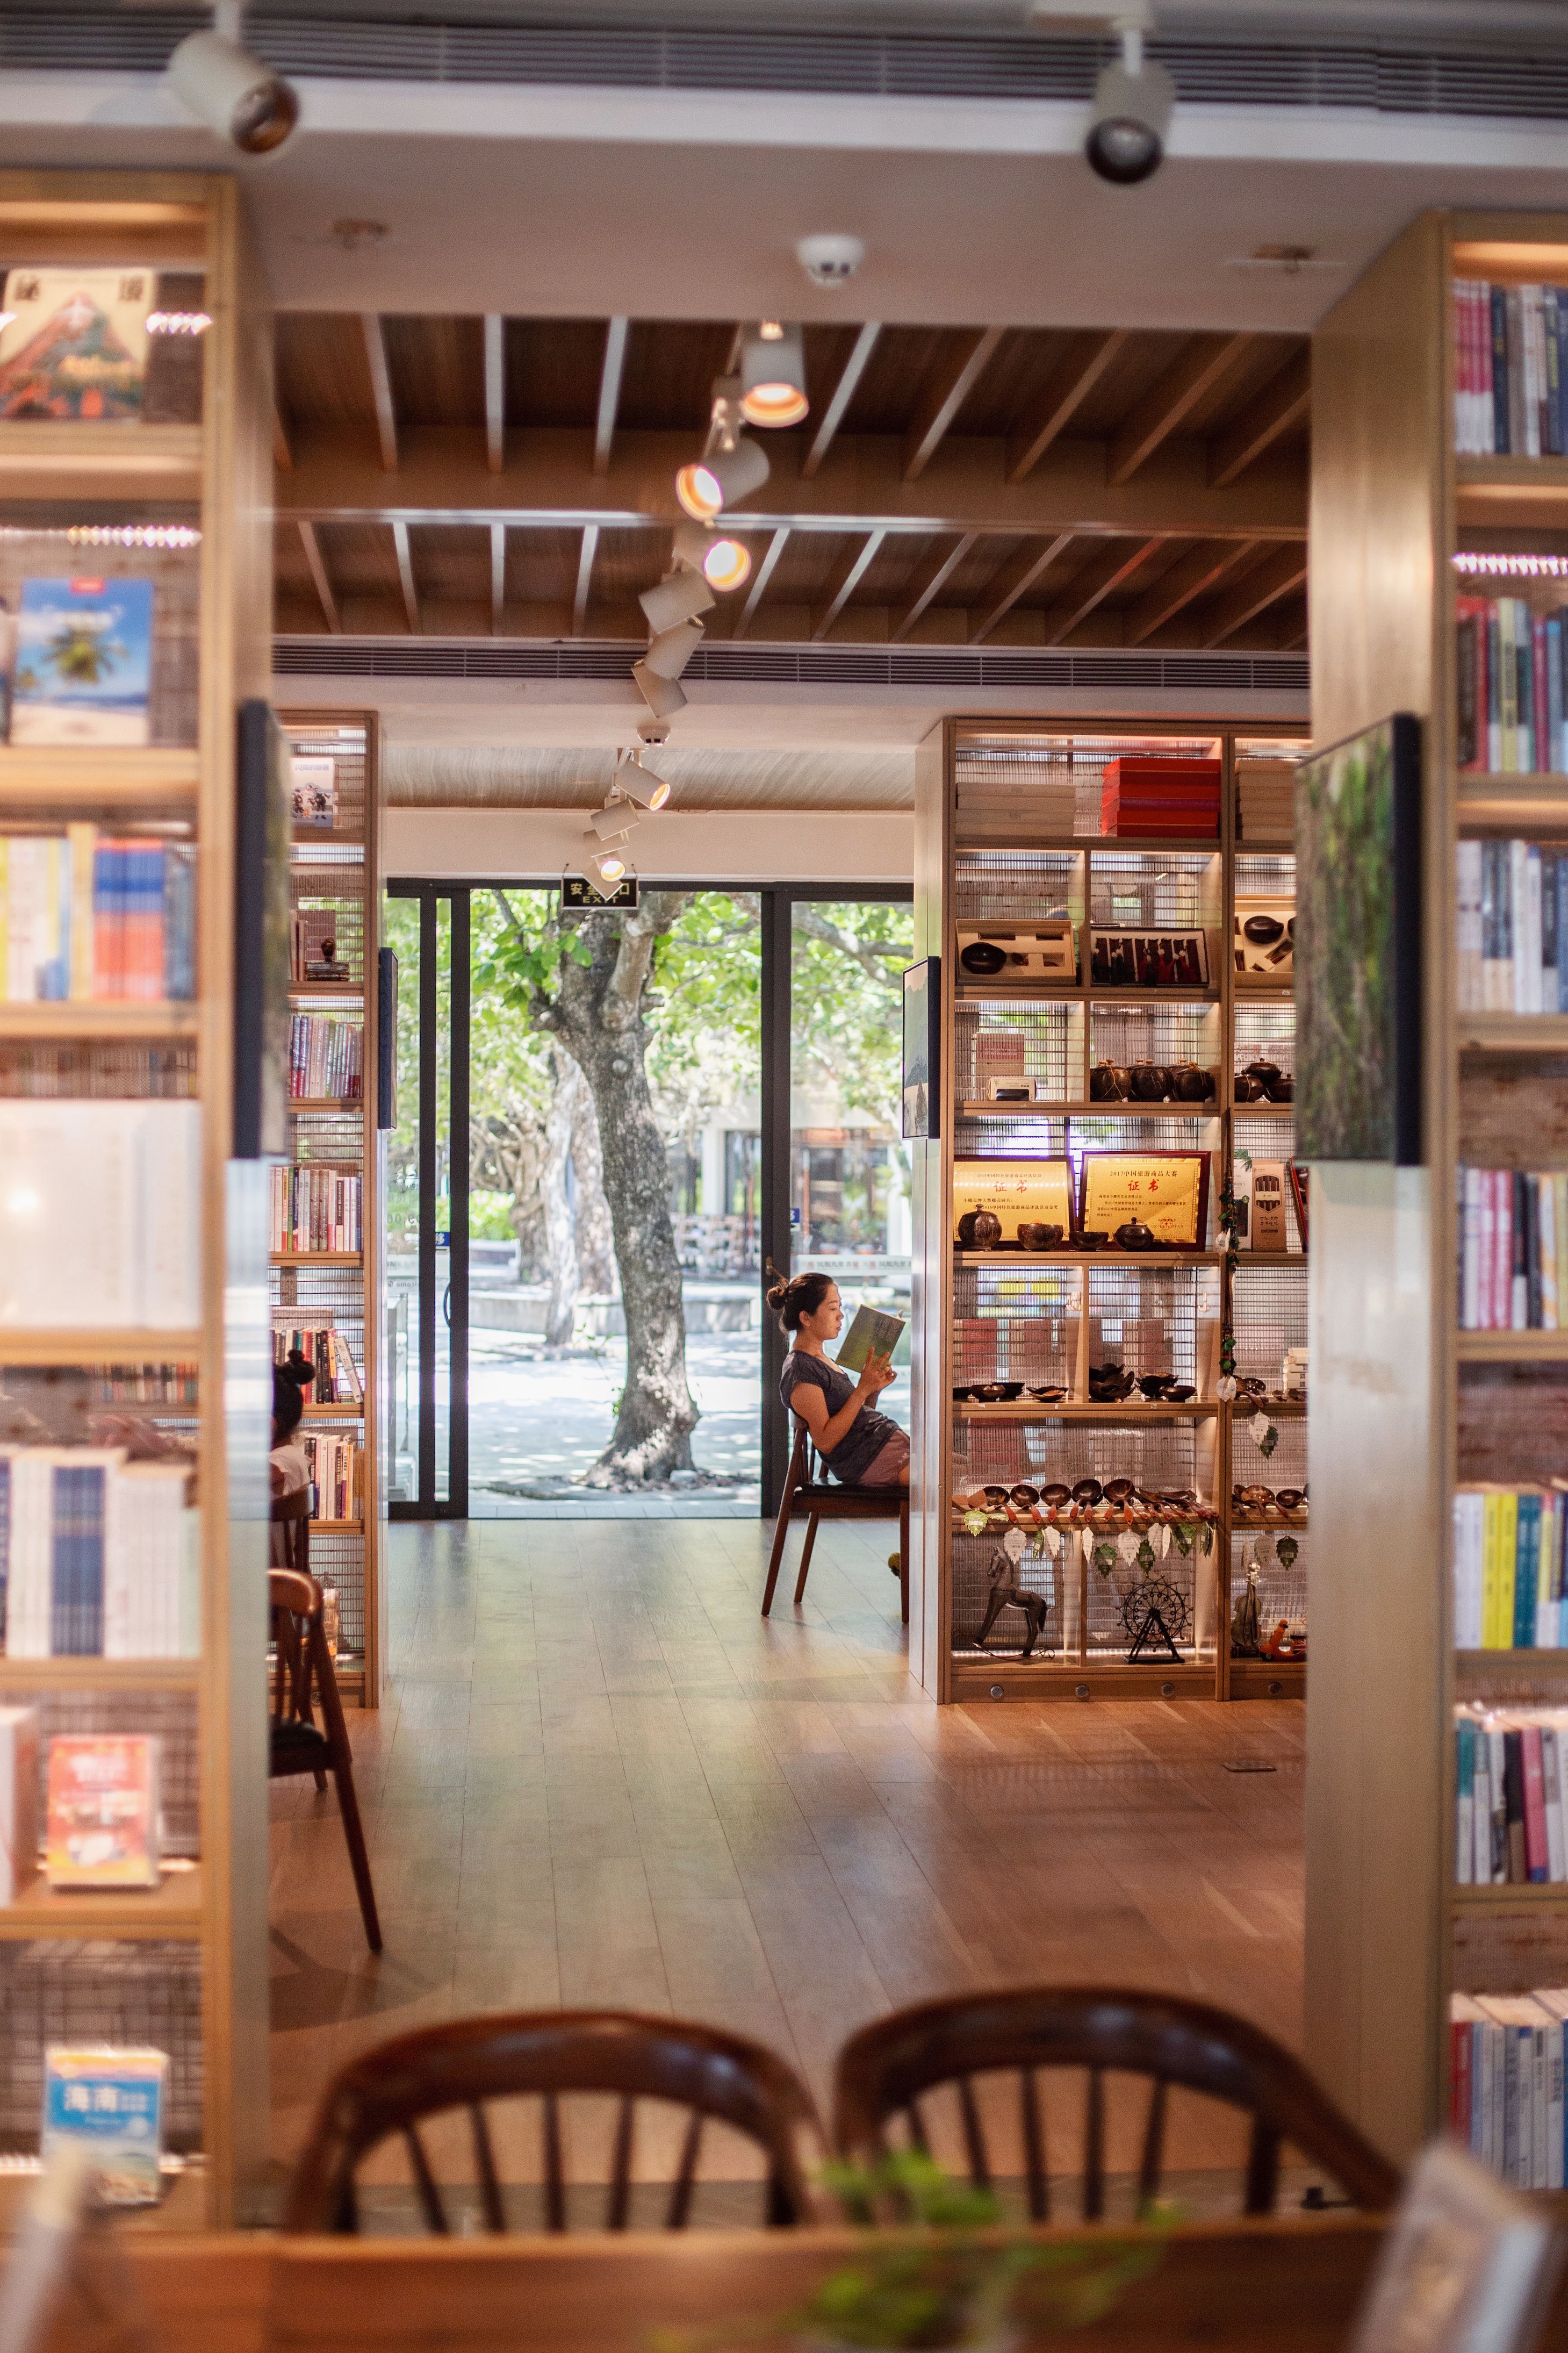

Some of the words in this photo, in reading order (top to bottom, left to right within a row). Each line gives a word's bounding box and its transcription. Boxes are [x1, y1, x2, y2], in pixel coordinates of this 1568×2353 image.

[570, 883, 630, 895] 安全口
[994, 1180, 1027, 1193] 证书
[1128, 1179, 1160, 1192] 证书
